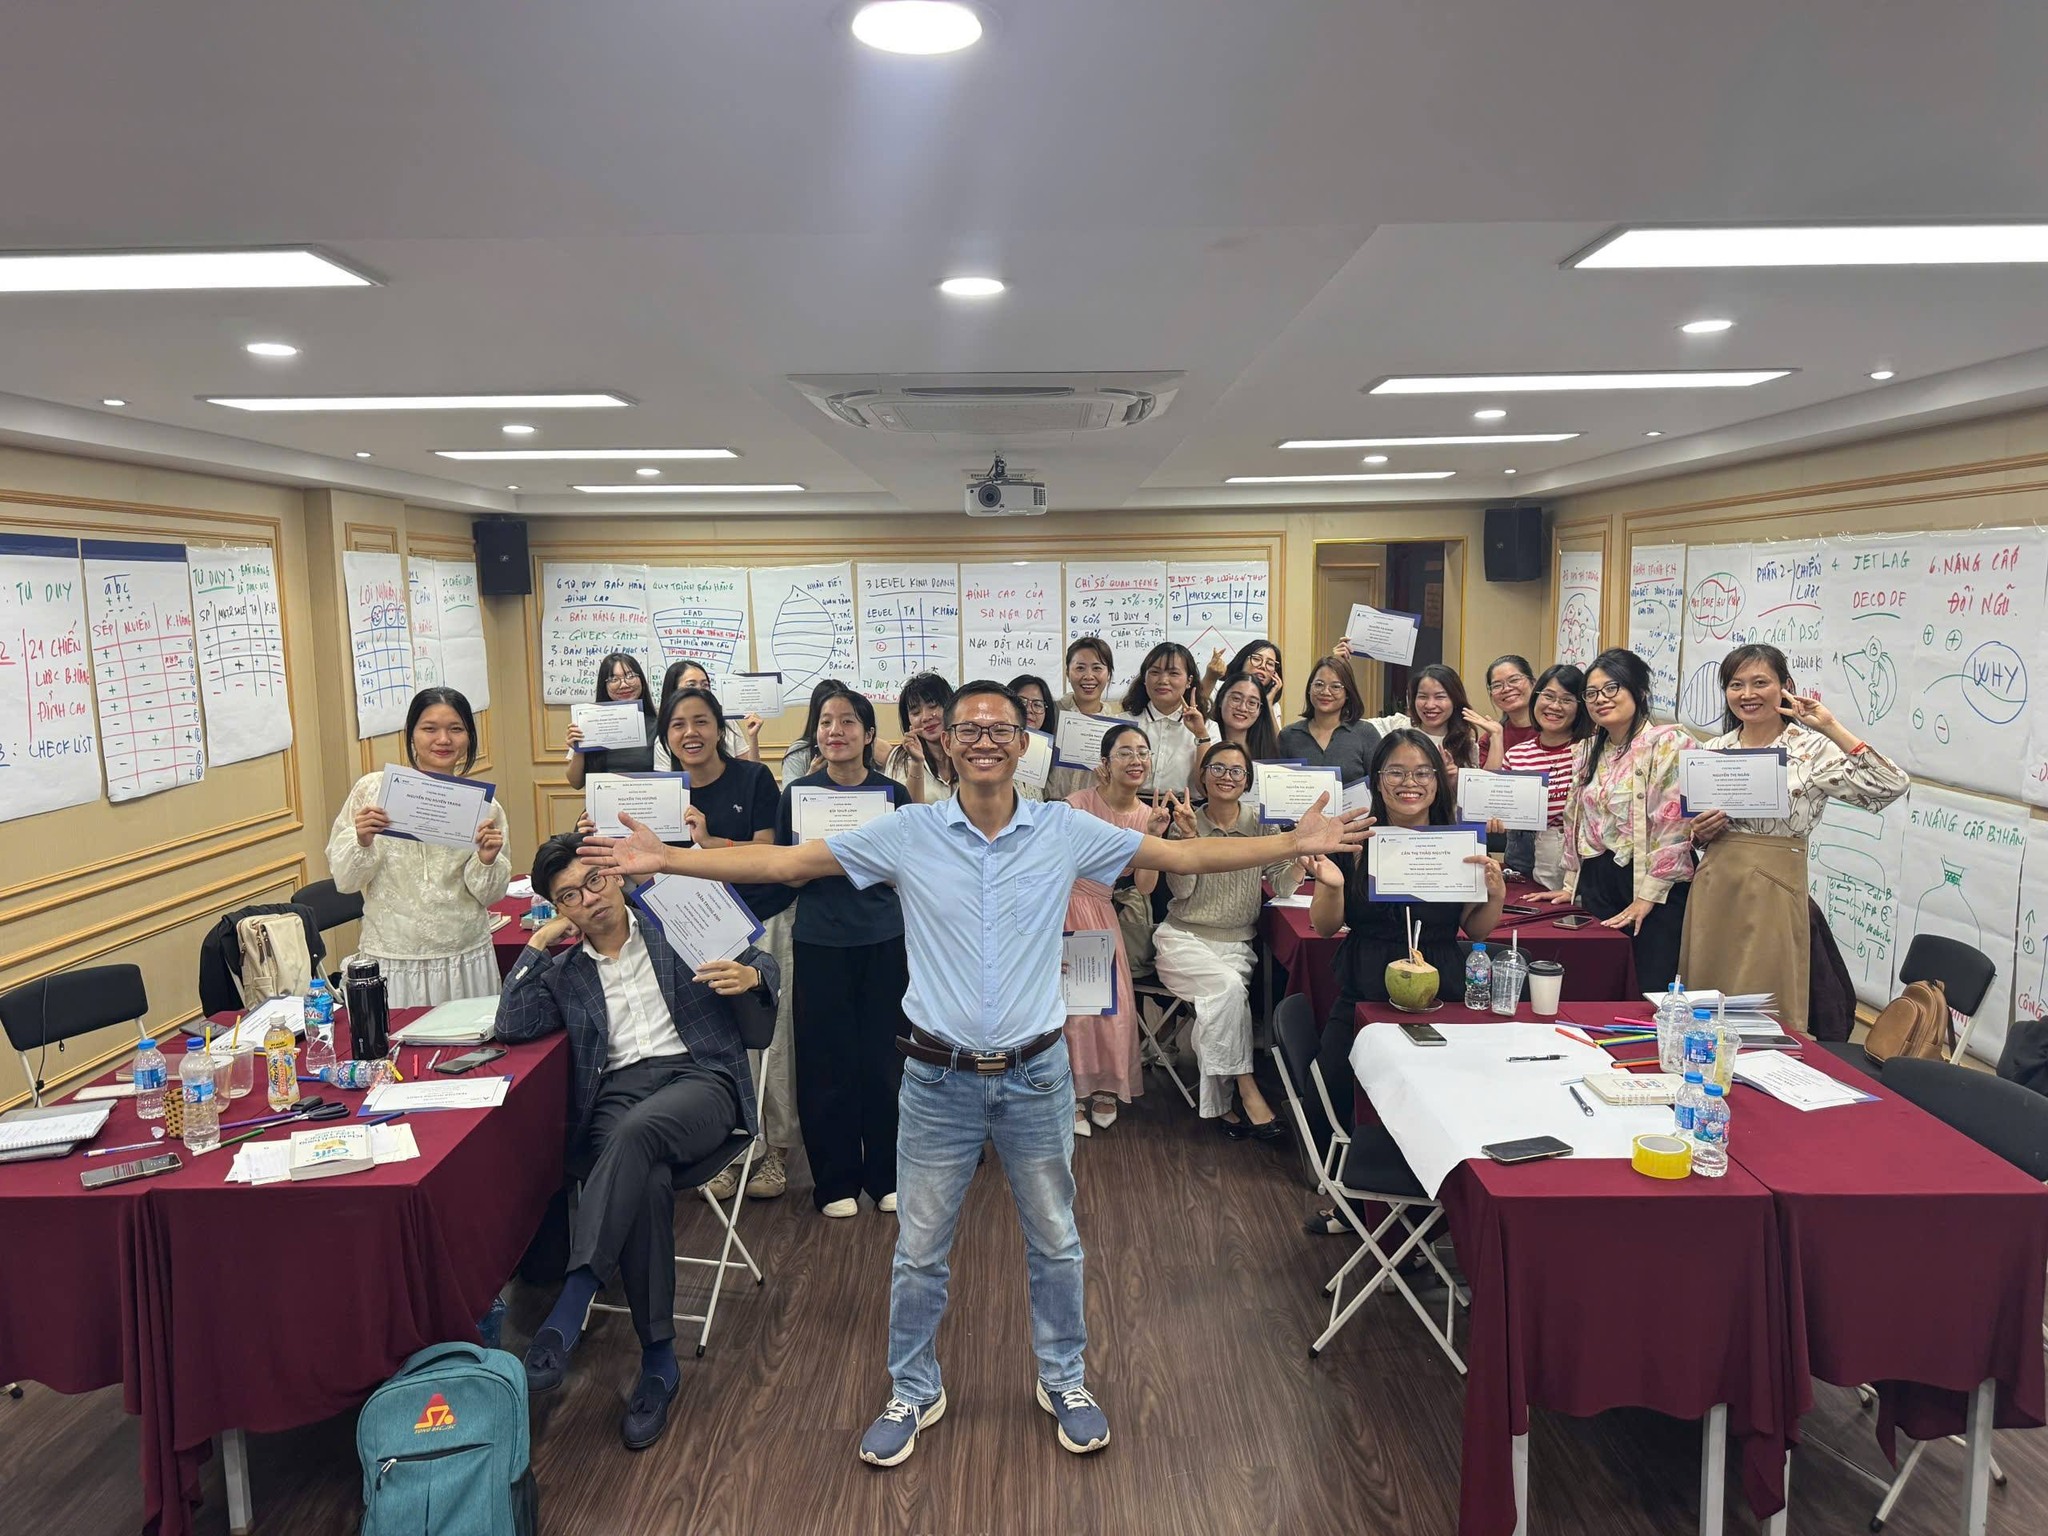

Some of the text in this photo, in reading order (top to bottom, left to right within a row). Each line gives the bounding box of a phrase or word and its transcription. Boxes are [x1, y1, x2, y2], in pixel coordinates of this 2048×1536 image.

[865, 578, 955, 589] 3 LEVEL KINH DOANH
[1109, 579, 1130, 588] QUAN
[966, 582, 1044, 600] ĐỈNH CAO CỦA
[1169, 590, 1180, 602] SP
[1853, 591, 1907, 609] DECODE
[867, 608, 893, 618] LEVEL
[904, 605, 915, 616] TA
[1083, 613, 1101, 624] 60%
[1124, 612, 1140, 621] DUY
[93, 611, 114, 637] SẾP
[569, 627, 607, 641] GIVERS
[29, 640, 43, 660] 21
[969, 638, 987, 649] NGU
[989, 651, 1012, 666] ĐỈNH
[1973, 657, 2018, 694] WHY
[1923, 808, 1958, 832] NÂNG
